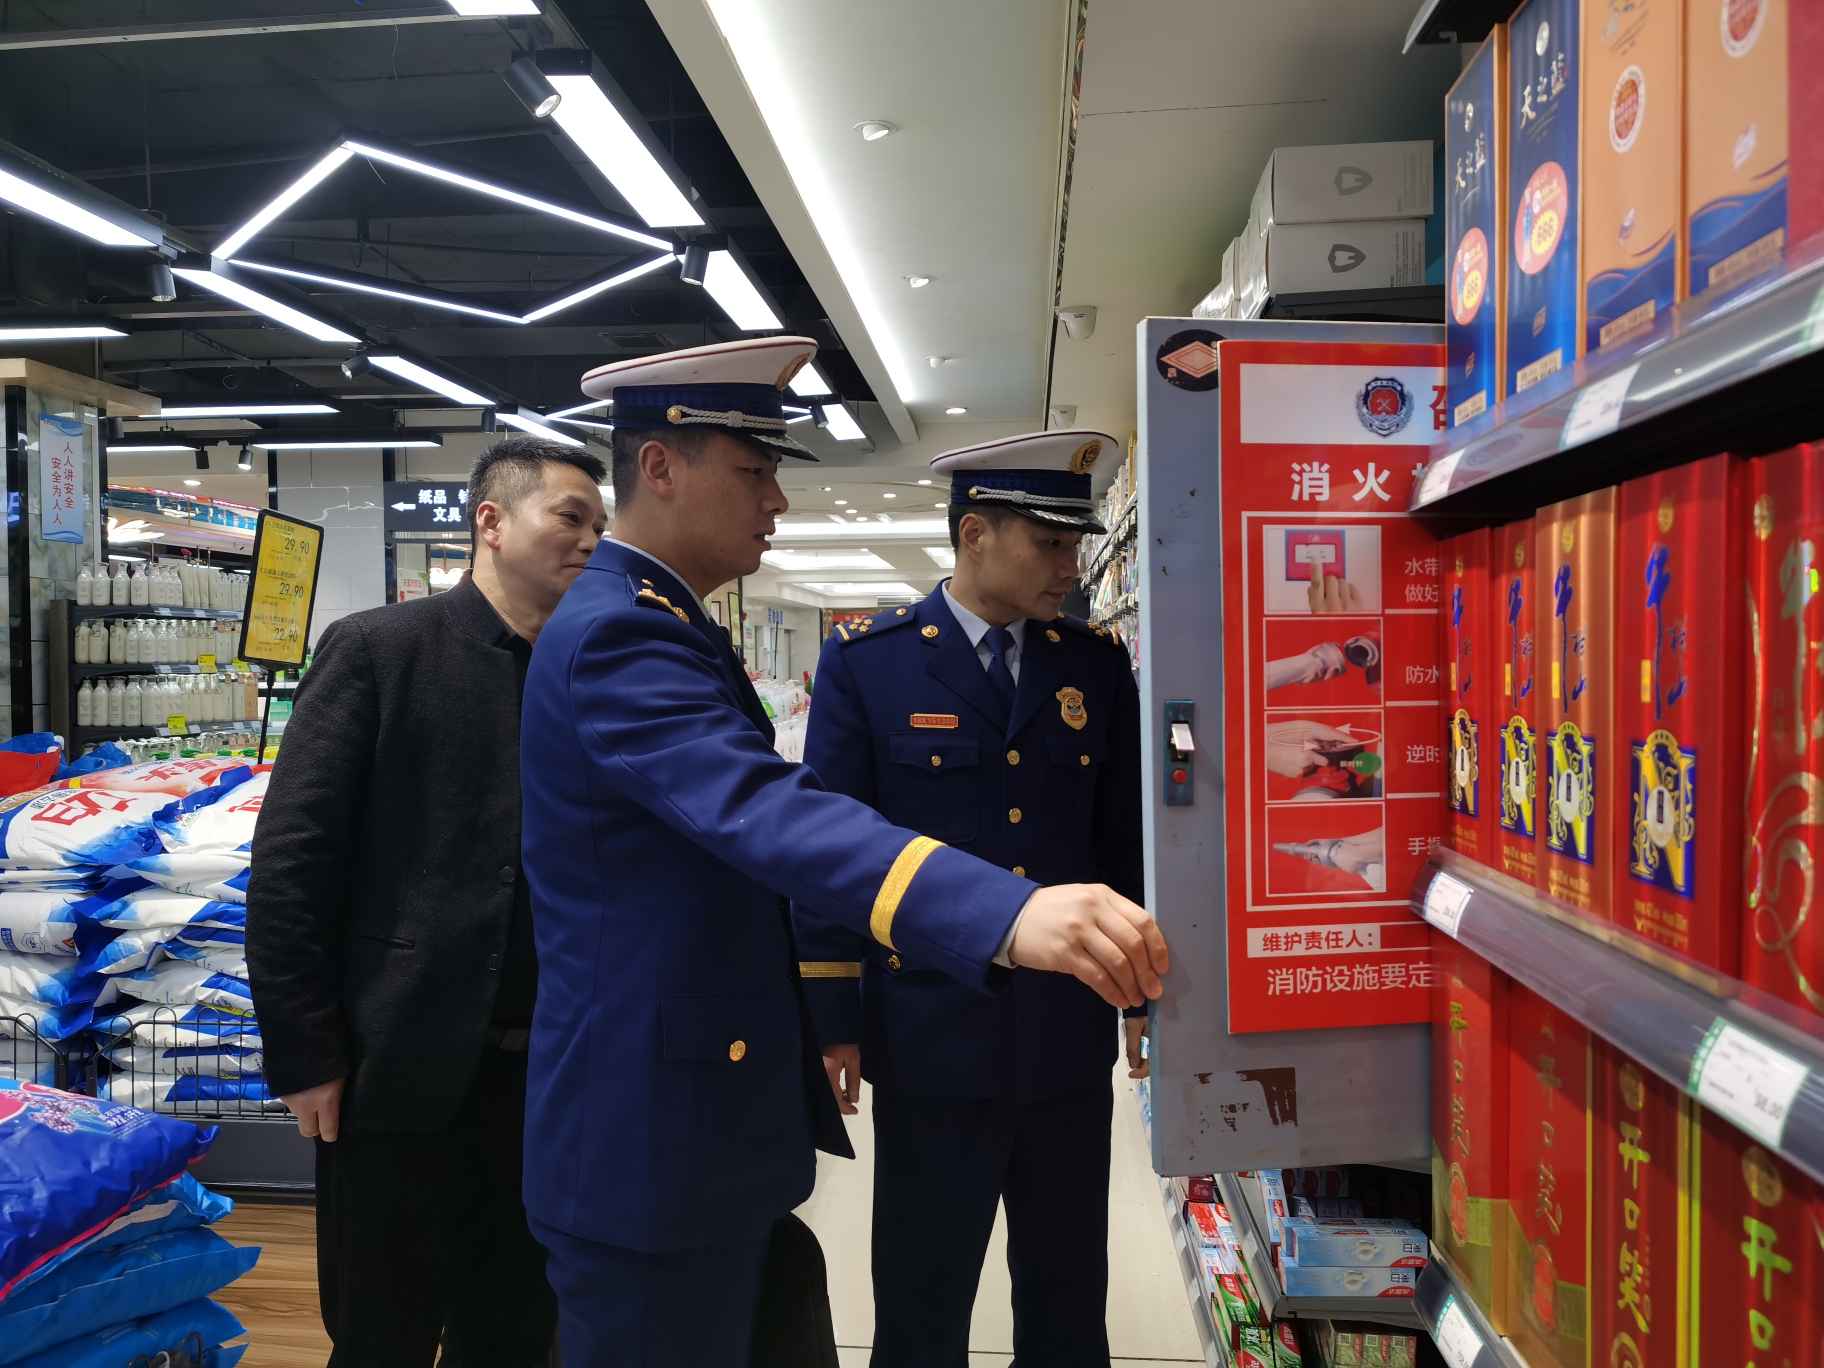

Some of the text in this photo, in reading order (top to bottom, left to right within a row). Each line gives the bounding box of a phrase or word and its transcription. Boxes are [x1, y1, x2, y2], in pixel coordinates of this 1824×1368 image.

[51, 456, 63, 526] 安全为人人
[63, 440, 75, 510] 人人讲安全
[418, 488, 448, 505] 纸品
[432, 506, 463, 522] 文具
[1741, 1214, 1793, 1368] 开口
